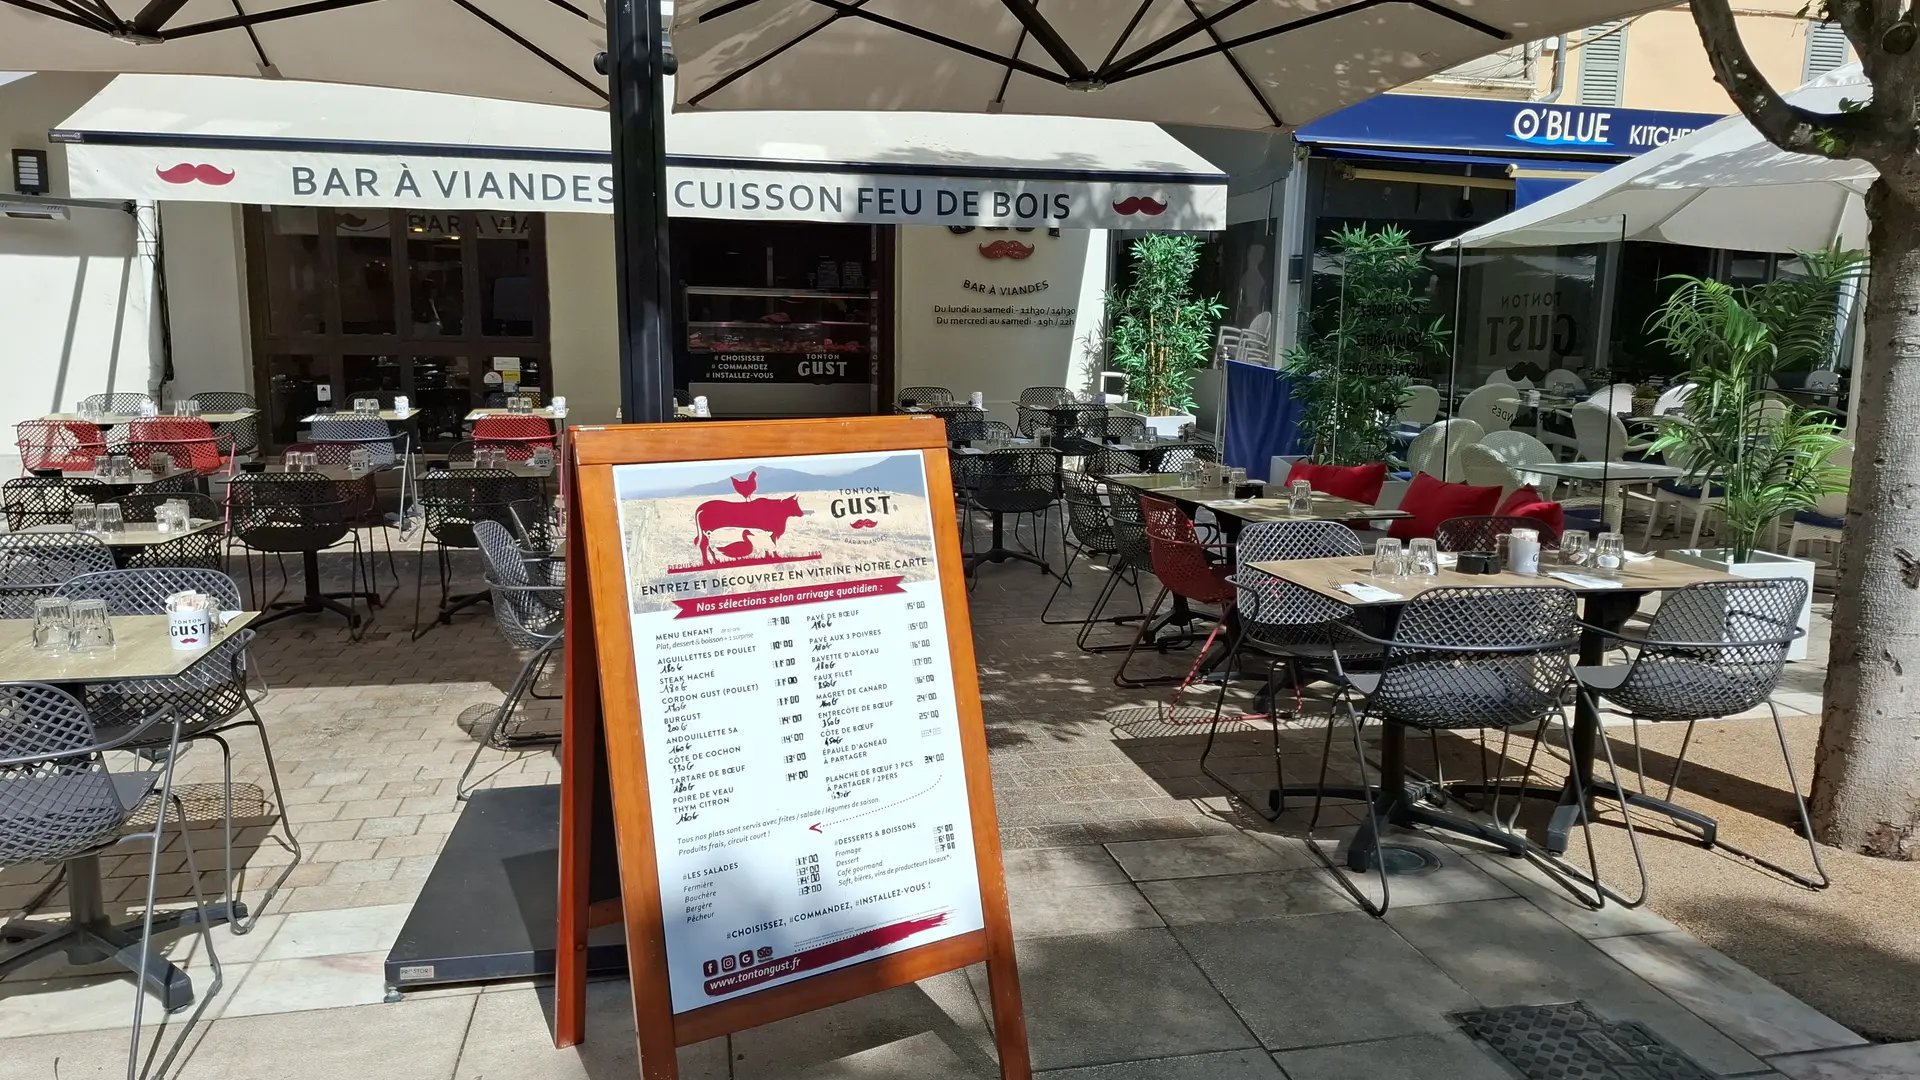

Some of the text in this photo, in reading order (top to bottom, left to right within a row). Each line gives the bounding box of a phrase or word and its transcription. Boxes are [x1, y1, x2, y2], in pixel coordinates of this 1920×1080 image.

[1513, 108, 1697, 147] O'BLUE KITCHE
[292, 162, 1071, 220] BAR À VIANDES CUISSON FEU DE BOIS
[963, 279, 1049, 296] BAR À VIANDES
[934, 305, 947, 314] Du
[948, 305, 970, 314] lundi
[983, 305, 1014, 314] samedi
[1020, 306, 1045, 315] 11h30
[1052, 306, 1076, 316] 14h30
[936, 317, 948, 325] Du
[950, 316, 988, 325] mercredi
[1001, 317, 1032, 326] samedi
[1038, 317, 1054, 327] 19h
[1060, 317, 1075, 326] 22h
[797, 361, 848, 377] GUST
[839, 486, 880, 496] TONTON
[830, 496, 890, 518] GUST
[641, 557, 928, 596] ENTREZ ET DÉCOUVREZ EN VITRINE NOTRE CARTE
[696, 583, 878, 612] Nos sélections selon arrivage quotidien
[806, 612, 825, 622] PAVÉ
[838, 609, 859, 618] BŒUF
[171, 622, 206, 637] GUST
[655, 627, 713, 641] MENU ENFANT
[809, 629, 882, 644] PAVÉ AUX 3 POIVRES
[672, 639, 695, 648] dessert
[701, 636, 724, 645] boisson
[732, 632, 754, 641] surprise
[657, 645, 757, 666] AIGUILLETTES DE POULET
[811, 647, 880, 663] BAVETTE D'ALOYAU
[660, 669, 715, 685] STEAK HACHÉ
[813, 670, 853, 682] FAUX FILET
[662, 683, 759, 705] CORDON GUST (POULET)
[816, 683, 888, 701] MAGRET DE CANARD
[663, 712, 701, 725] BURGUST
[818, 701, 894, 719] ENTRECÔTE DE BŒUF
[666, 728, 726, 744] ANDOUILLETTE
[820, 722, 874, 738] CÔTE DE BŒUF
[668, 745, 741, 765] CÔTE DE COCHON
[822, 738, 888, 756] ÉPAULE D'AGNEAU
[830, 751, 868, 763] PARTAGER
[670, 764, 746, 785] TARTARE DE BŒUF
[825, 771, 859, 783] PLANCHE
[860, 768, 870, 776] DE
[871, 764, 893, 774] BŒUF
[900, 760, 914, 769] PCS
[833, 778, 871, 791] PARTAGER
[877, 772, 898, 782] 2PERS
[672, 786, 734, 805] POIRE DE VEAU
[673, 796, 730, 814] THYM CITRON
[677, 836, 694, 845] Tous
[708, 829, 726, 840] plats
[726, 825, 742, 834] sont
[742, 821, 761, 832] servis
[762, 818, 777, 827] avec
[777, 813, 796, 827] frites
[800, 808, 821, 819] salade
[825, 803, 851, 814] légumes
[851, 800, 860, 808] de
[834, 831, 873, 846] #DESSERTS
[881, 822, 917, 836] BOISSONS
[678, 832, 767, 856] Produits frais, circuit court
[835, 847, 862, 858] Fromage
[836, 856, 860, 868] Dessert
[837, 860, 883, 877] Café gourmand
[683, 862, 739, 880] #LES SALADES
[838, 877, 853, 887] Soft,
[854, 871, 874, 883] bières,
[874, 868, 886, 877] vins
[886, 867, 894, 875] de
[894, 860, 928, 874] producteurs
[683, 880, 714, 893] Fermière
[684, 890, 717, 903] Bouchère
[685, 902, 713, 913] Bergère
[726, 918, 787, 940] #CHOISISSEZ,
[789, 902, 853, 923] #COMMANDEZ,
[855, 882, 926, 906] #INSTALLEZ-VOUS
[686, 912, 715, 924] Pêcheur
[710, 956, 801, 991] www.tontongust.fr
